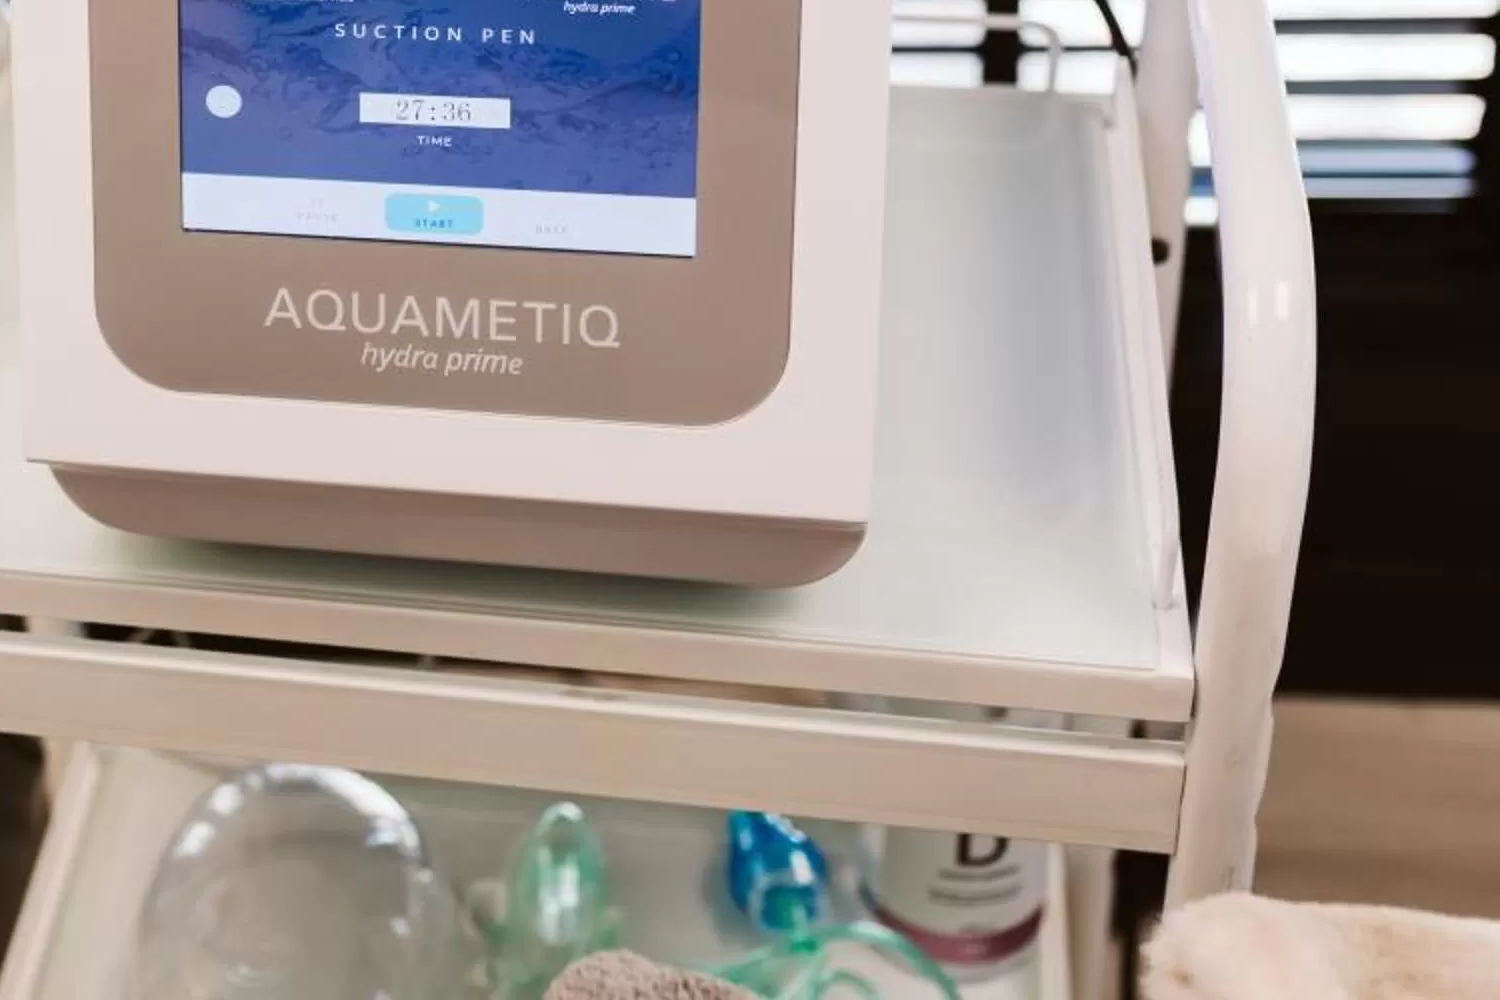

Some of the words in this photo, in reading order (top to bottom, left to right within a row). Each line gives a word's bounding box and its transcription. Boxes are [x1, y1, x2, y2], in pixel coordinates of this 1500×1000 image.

[563, 1, 599, 15] hydra
[599, 3, 636, 16] prime
[334, 22, 463, 43] SUCTION
[481, 28, 536, 45] PEN
[395, 98, 472, 122] 27:36
[415, 134, 453, 148] TIME
[263, 286, 621, 349] AQUAMETIQ
[360, 341, 438, 373] hydra
[443, 347, 524, 377] prime
